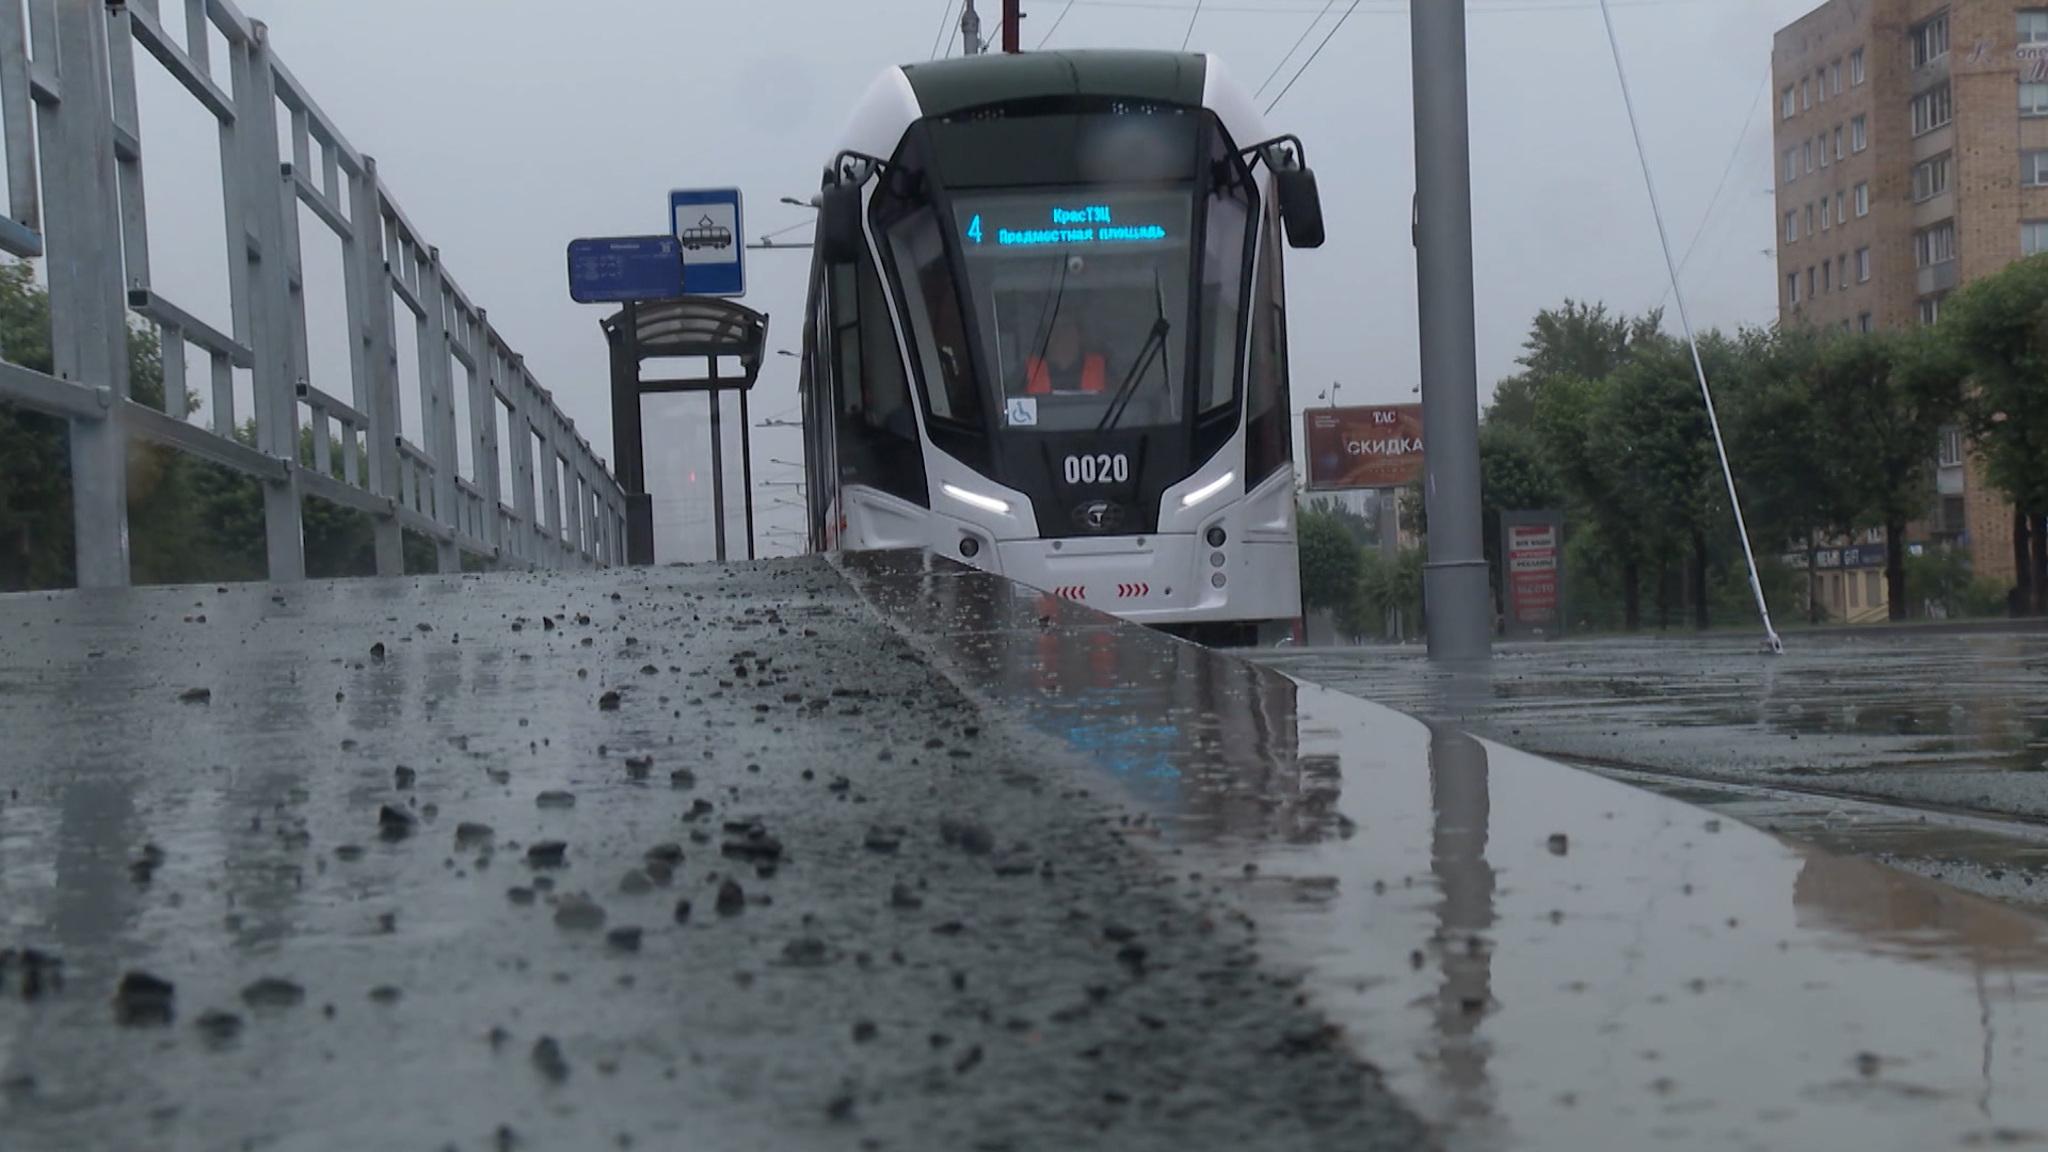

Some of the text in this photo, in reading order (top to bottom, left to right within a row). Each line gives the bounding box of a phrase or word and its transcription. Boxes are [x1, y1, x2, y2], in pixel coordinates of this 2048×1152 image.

[1052, 206, 1111, 224] КрасТЭЦ
[966, 214, 983, 244] 4
[998, 225, 1166, 244] Предмостная площадь
[1347, 437, 1424, 455] СКИДКА
[1064, 453, 1129, 484] 0020
